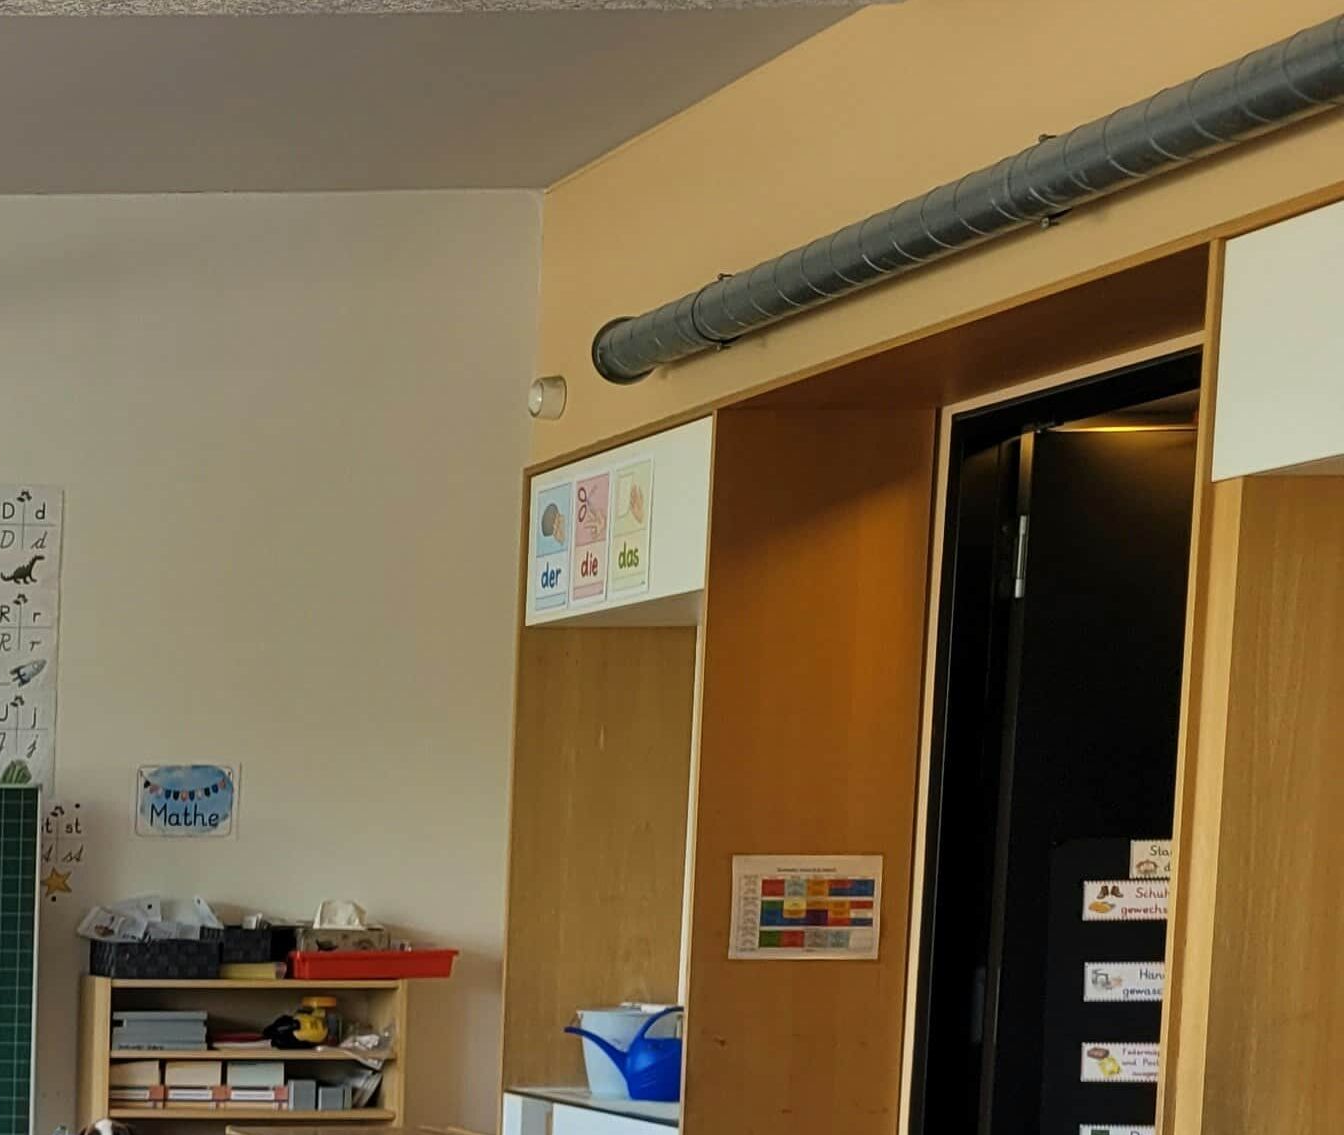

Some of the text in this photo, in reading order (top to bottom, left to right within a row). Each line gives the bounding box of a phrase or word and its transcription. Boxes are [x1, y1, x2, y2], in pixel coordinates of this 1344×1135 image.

[3, 502, 15, 519] D
[35, 503, 45, 519] d
[581, 551, 598, 577] die
[618, 541, 639, 569] das
[541, 562, 562, 589] der
[0, 605, 10, 622] R
[33, 612, 41, 622] r
[31, 708, 36, 729] j
[149, 803, 219, 828] Mathe
[65, 818, 81, 833] st
[1136, 887, 1169, 899] Schuh
[1121, 905, 1168, 916] gewechs
